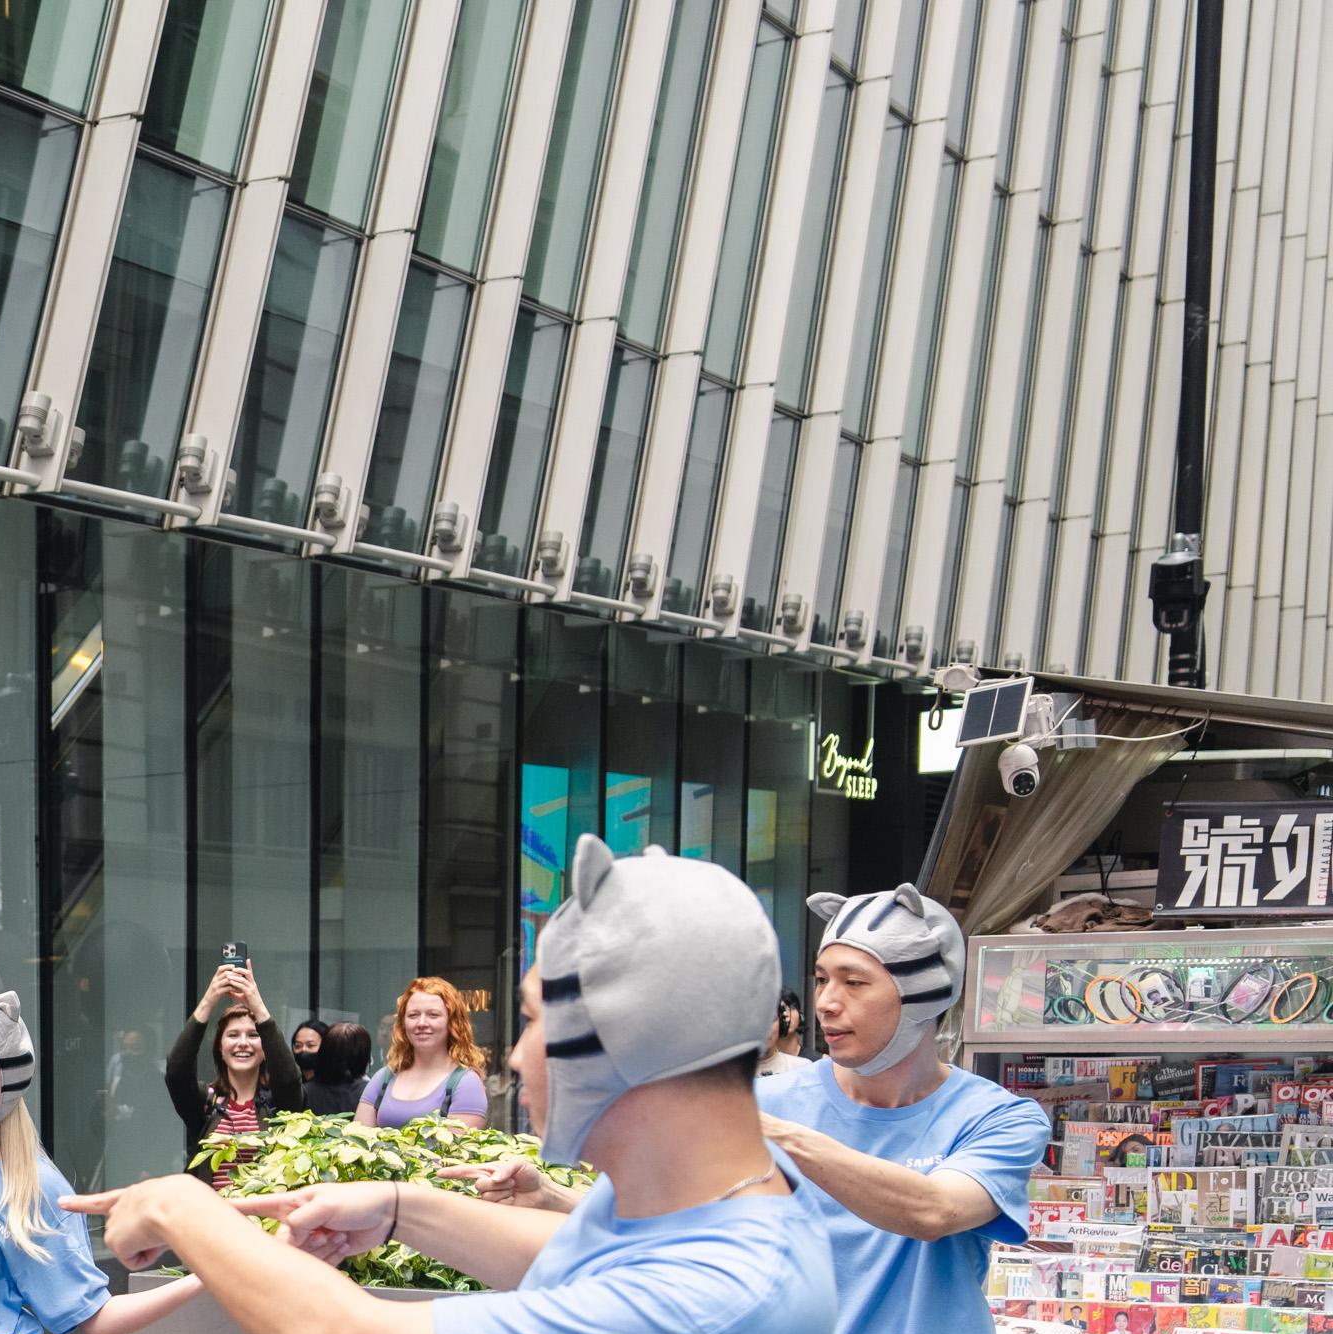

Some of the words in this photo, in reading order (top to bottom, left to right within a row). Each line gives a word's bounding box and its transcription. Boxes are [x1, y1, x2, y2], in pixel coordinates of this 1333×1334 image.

[822, 733, 874, 788] Beyond
[845, 775, 878, 800] SLEEP
[1155, 1068, 1196, 1081] Guardian
[1162, 1067, 1177, 1075] The
[905, 1154, 944, 1168] SAMS
[1068, 1226, 1118, 1238] ArtReview
